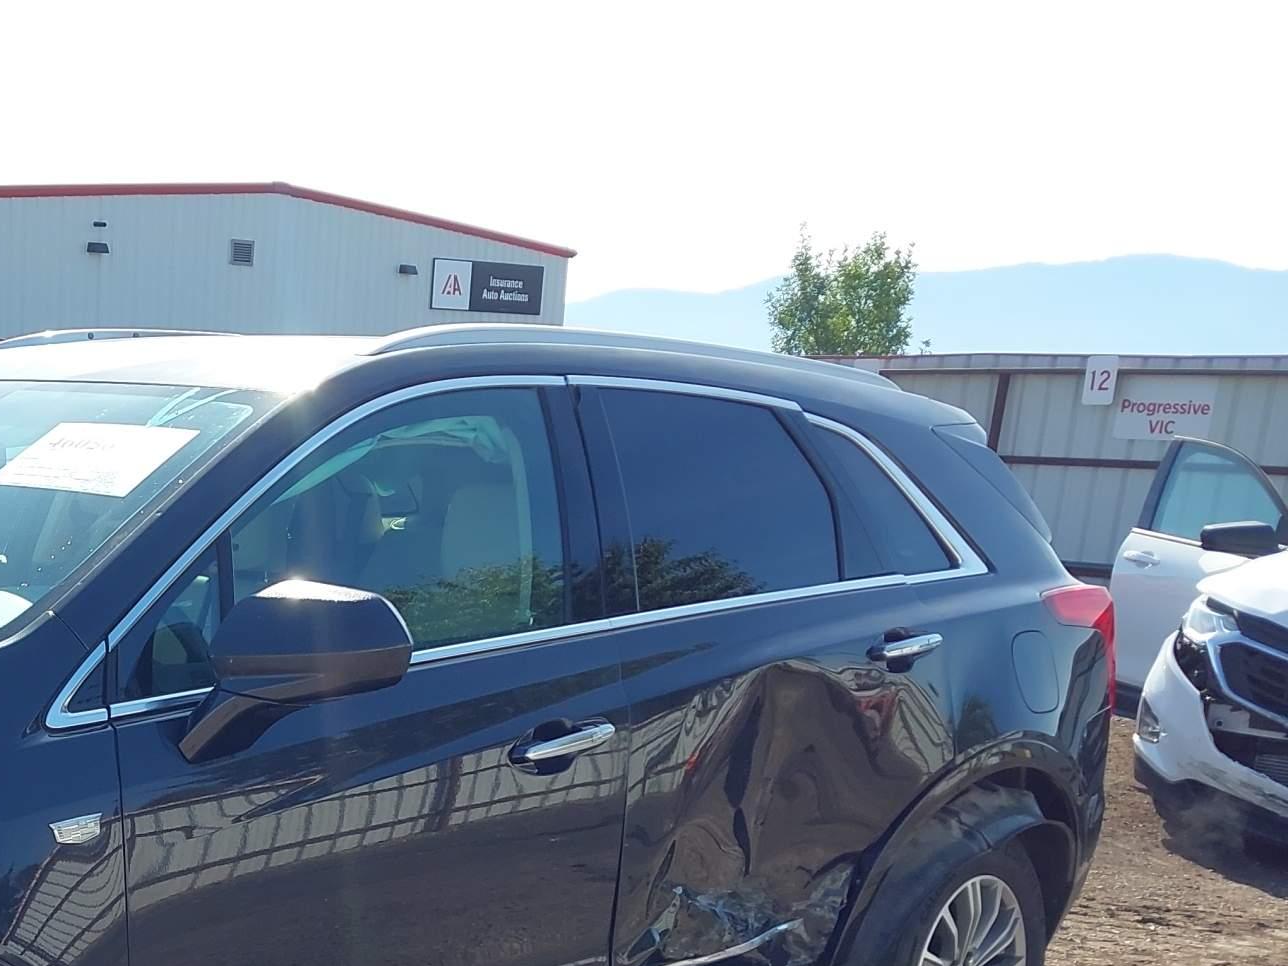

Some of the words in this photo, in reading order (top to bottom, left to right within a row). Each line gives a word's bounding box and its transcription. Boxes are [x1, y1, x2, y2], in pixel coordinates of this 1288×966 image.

[489, 275, 523, 289] Insurance
[482, 288, 498, 300] Auto
[499, 289, 529, 302] Auctions
[1090, 370, 1111, 391] 12
[1120, 399, 1210, 416] Progressive
[1149, 420, 1175, 434] VIC
